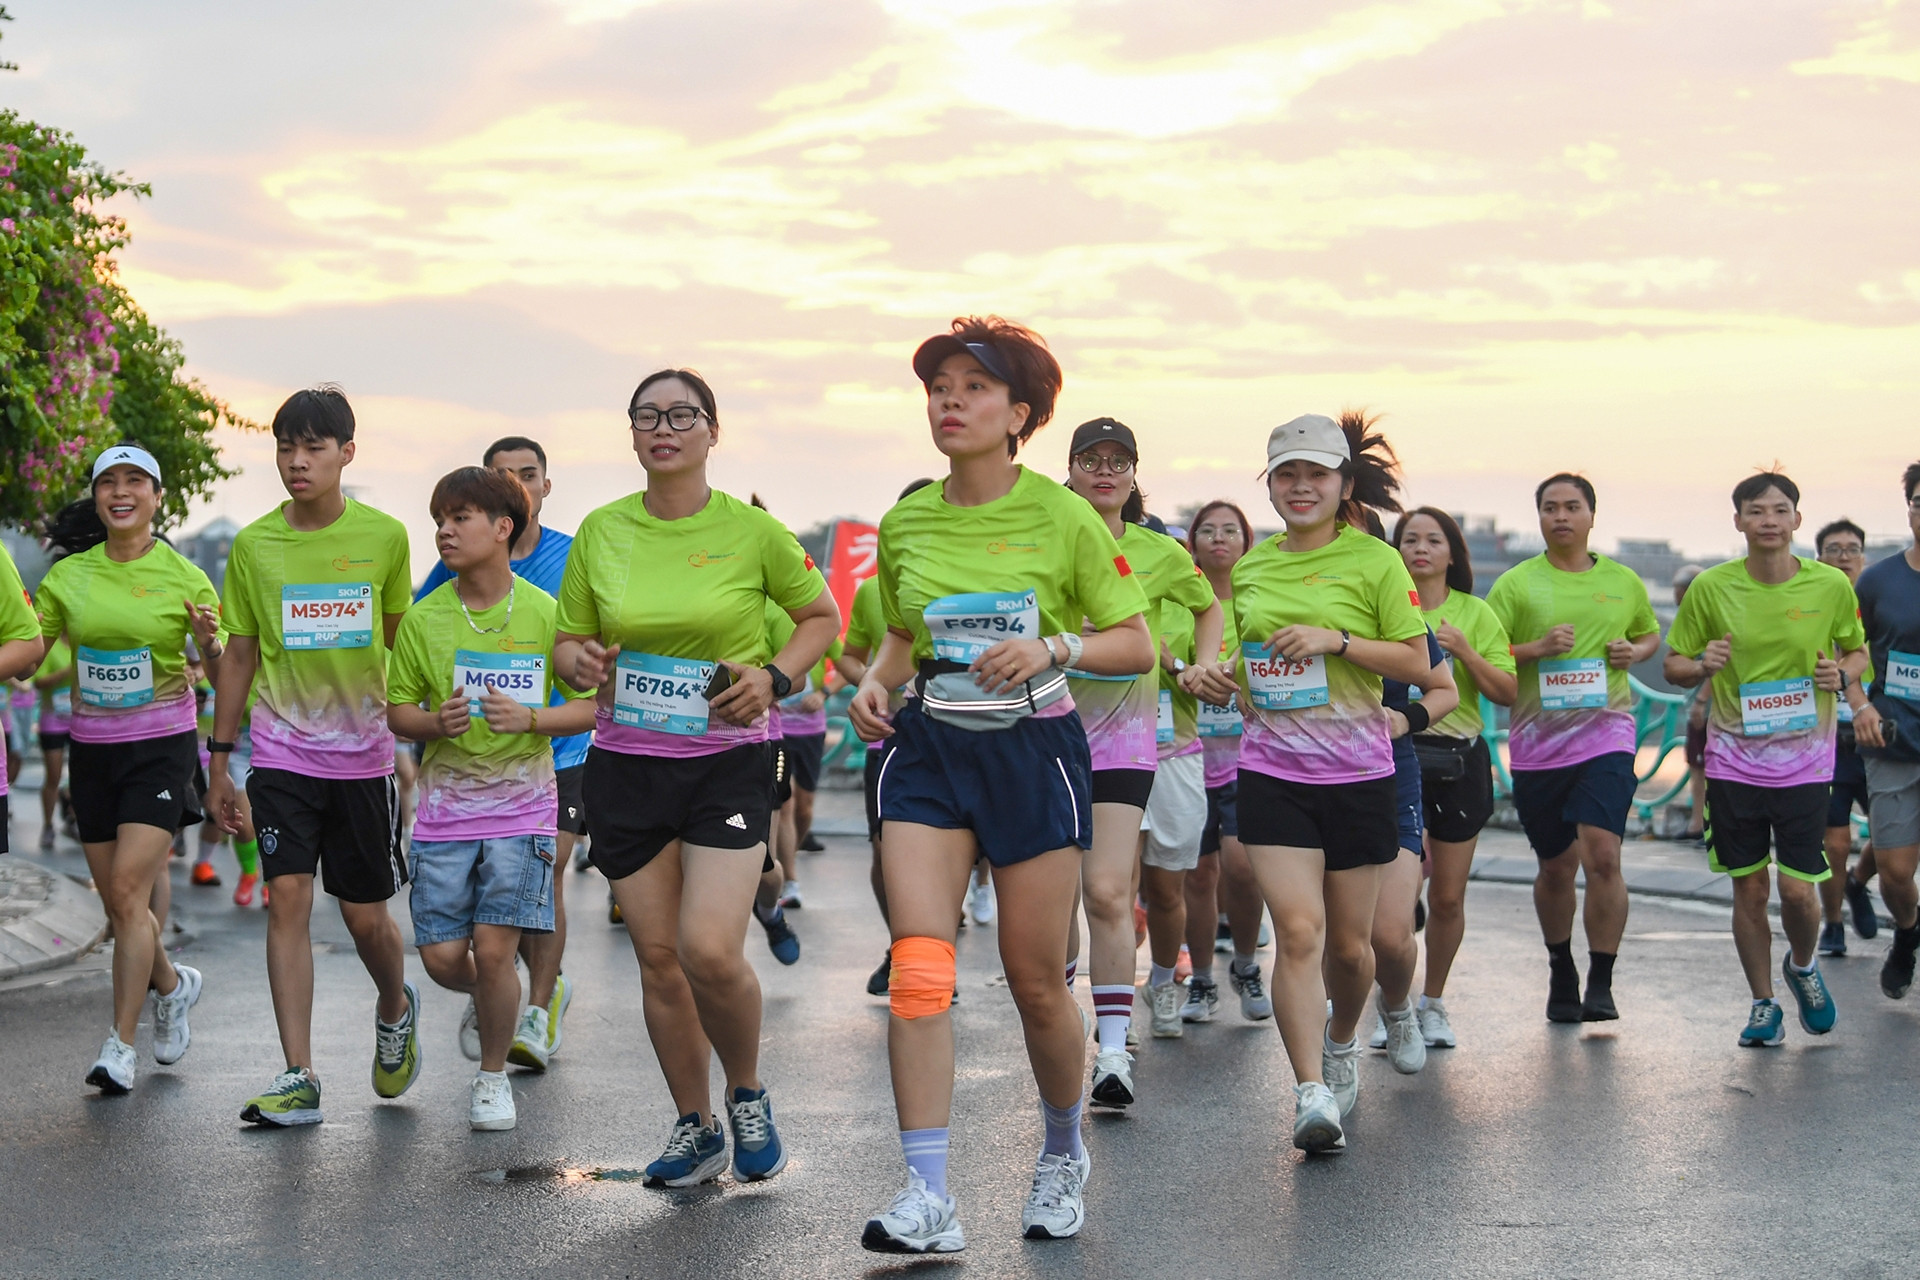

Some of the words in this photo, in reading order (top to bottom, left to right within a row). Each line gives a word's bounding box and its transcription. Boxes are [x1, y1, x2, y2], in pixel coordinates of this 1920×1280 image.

[338, 588, 359, 597] 5KM
[362, 587, 370, 596] P
[996, 600, 1023, 611] 5KM
[1026, 595, 1034, 605] V
[943, 616, 1025, 634] F6794
[141, 651, 148, 660] V
[510, 659, 532, 669] 5KM
[534, 660, 543, 669] K
[673, 664, 697, 676] 5KM
[701, 667, 710, 677] V
[87, 665, 141, 682] F6630
[1896, 665, 1920, 679] M6
[465, 670, 534, 690] M6035
